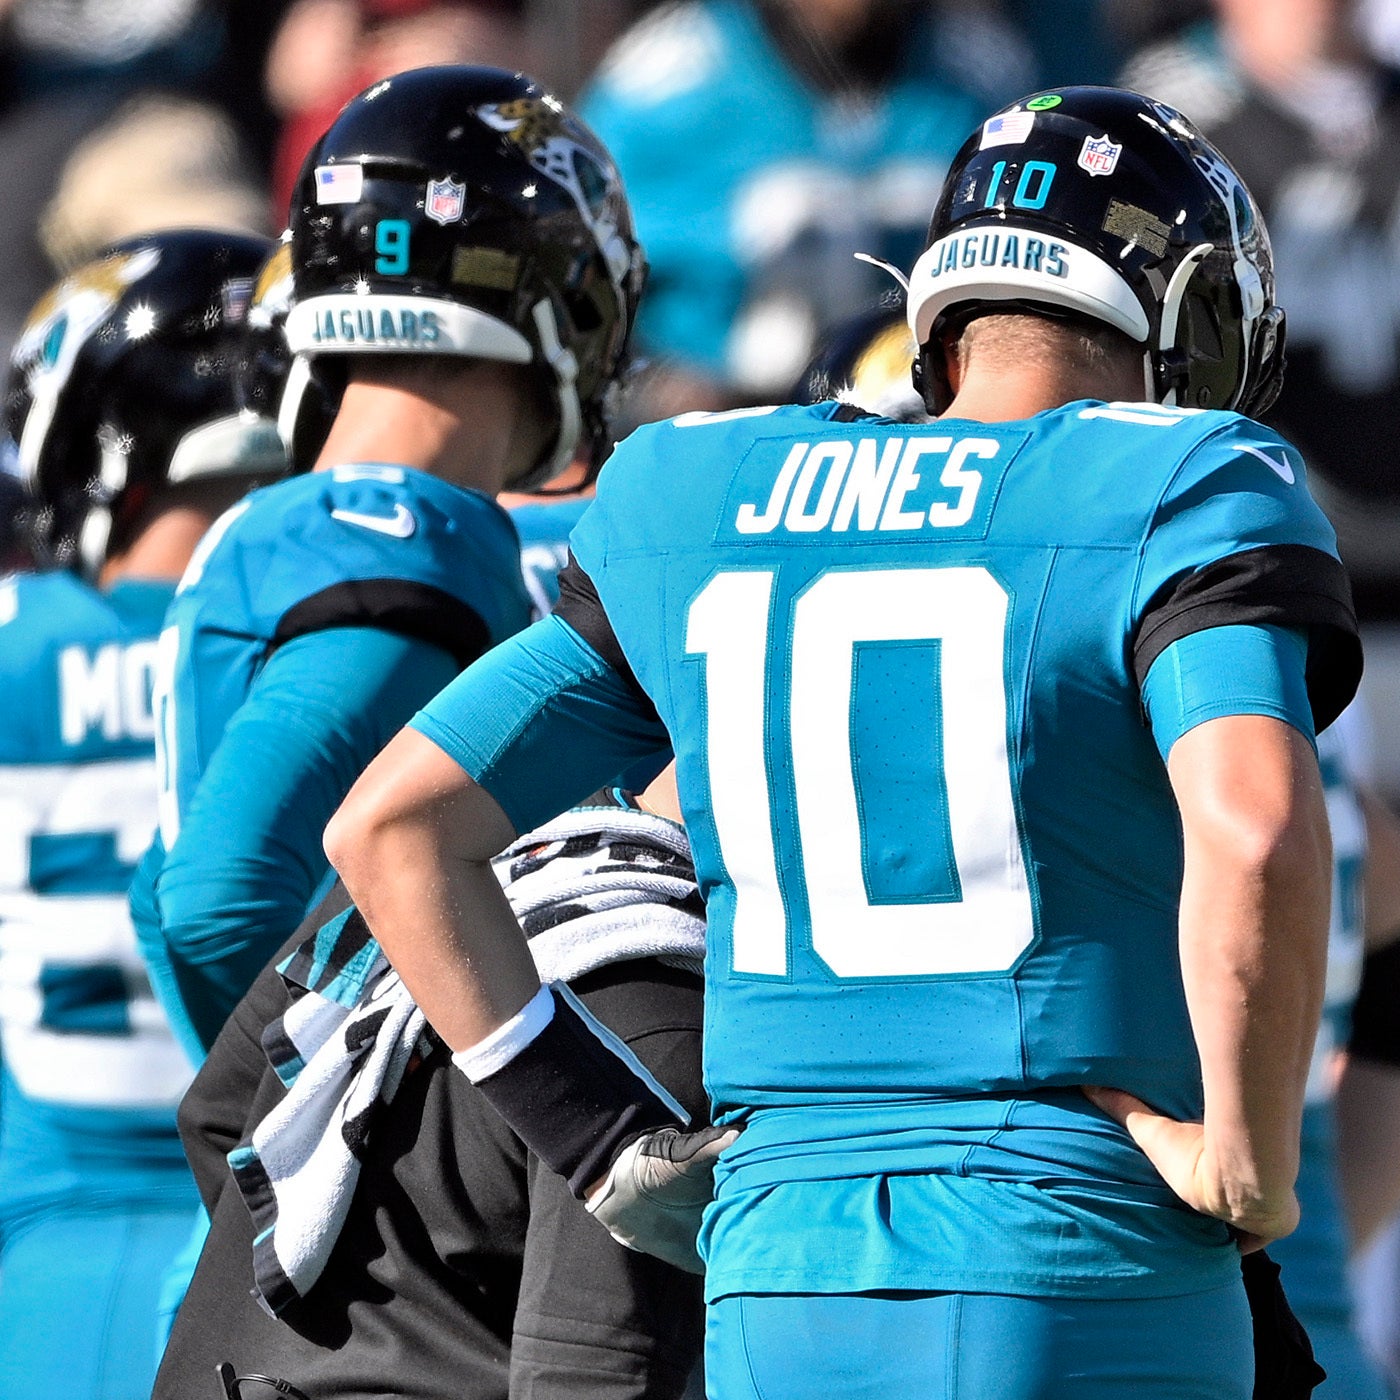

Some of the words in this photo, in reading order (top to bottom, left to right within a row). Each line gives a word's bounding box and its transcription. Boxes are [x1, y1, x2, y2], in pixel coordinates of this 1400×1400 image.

[984, 160, 1058, 211] 10
[1085, 151, 1110, 171] NFL
[374, 218, 411, 276] 9
[931, 234, 1069, 279] JAGUARS
[312, 307, 441, 343] JAGUARS
[735, 437, 1000, 535] JONES
[684, 566, 1038, 979] 10
